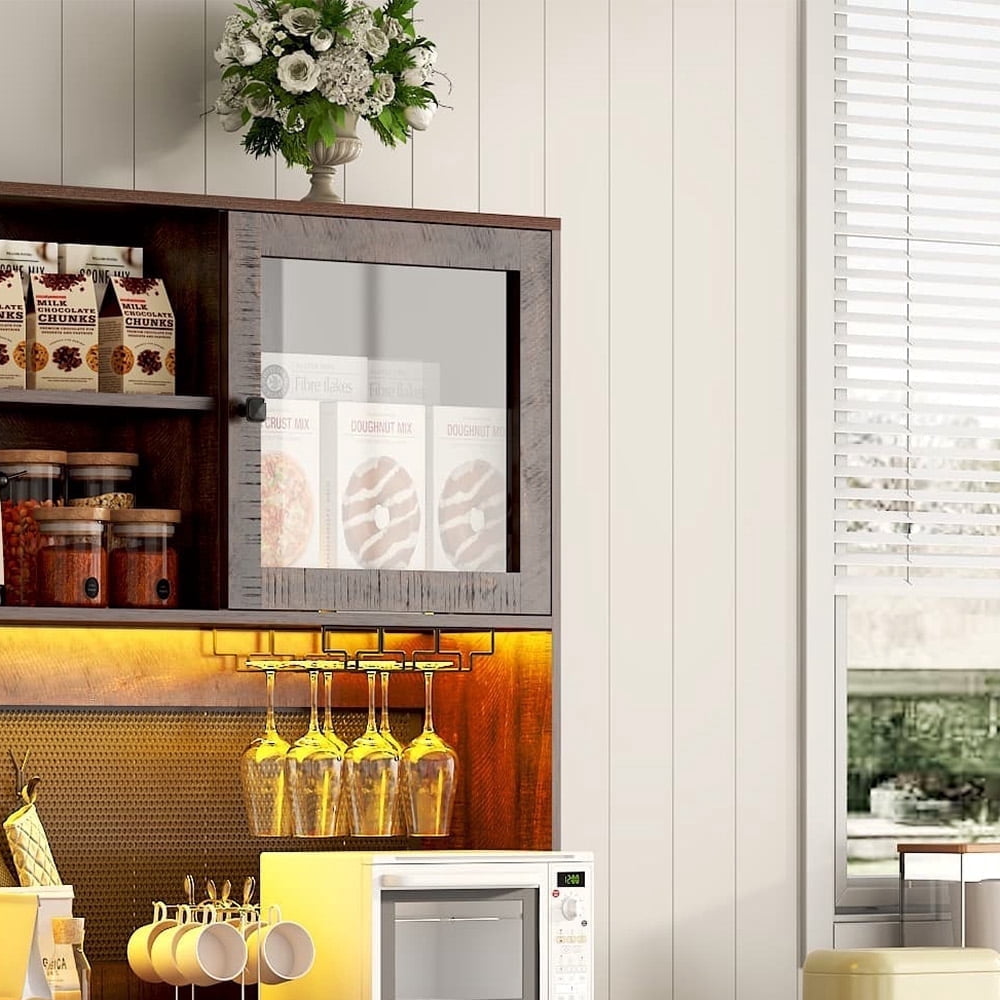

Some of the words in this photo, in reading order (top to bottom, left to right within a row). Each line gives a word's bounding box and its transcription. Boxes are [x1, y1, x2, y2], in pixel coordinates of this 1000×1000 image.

[38, 307, 96, 315] CHOCOLATE
[121, 303, 148, 311] MILK
[38, 314, 96, 323] CHUNKS
[124, 310, 173, 319] CHOCOLATE
[125, 318, 174, 328] CHUNKS
[294, 417, 310, 430] MIX
[351, 419, 395, 434] DOUGHNUT
[397, 421, 413, 435] MIX
[447, 423, 490, 437] DOUGHNUT
